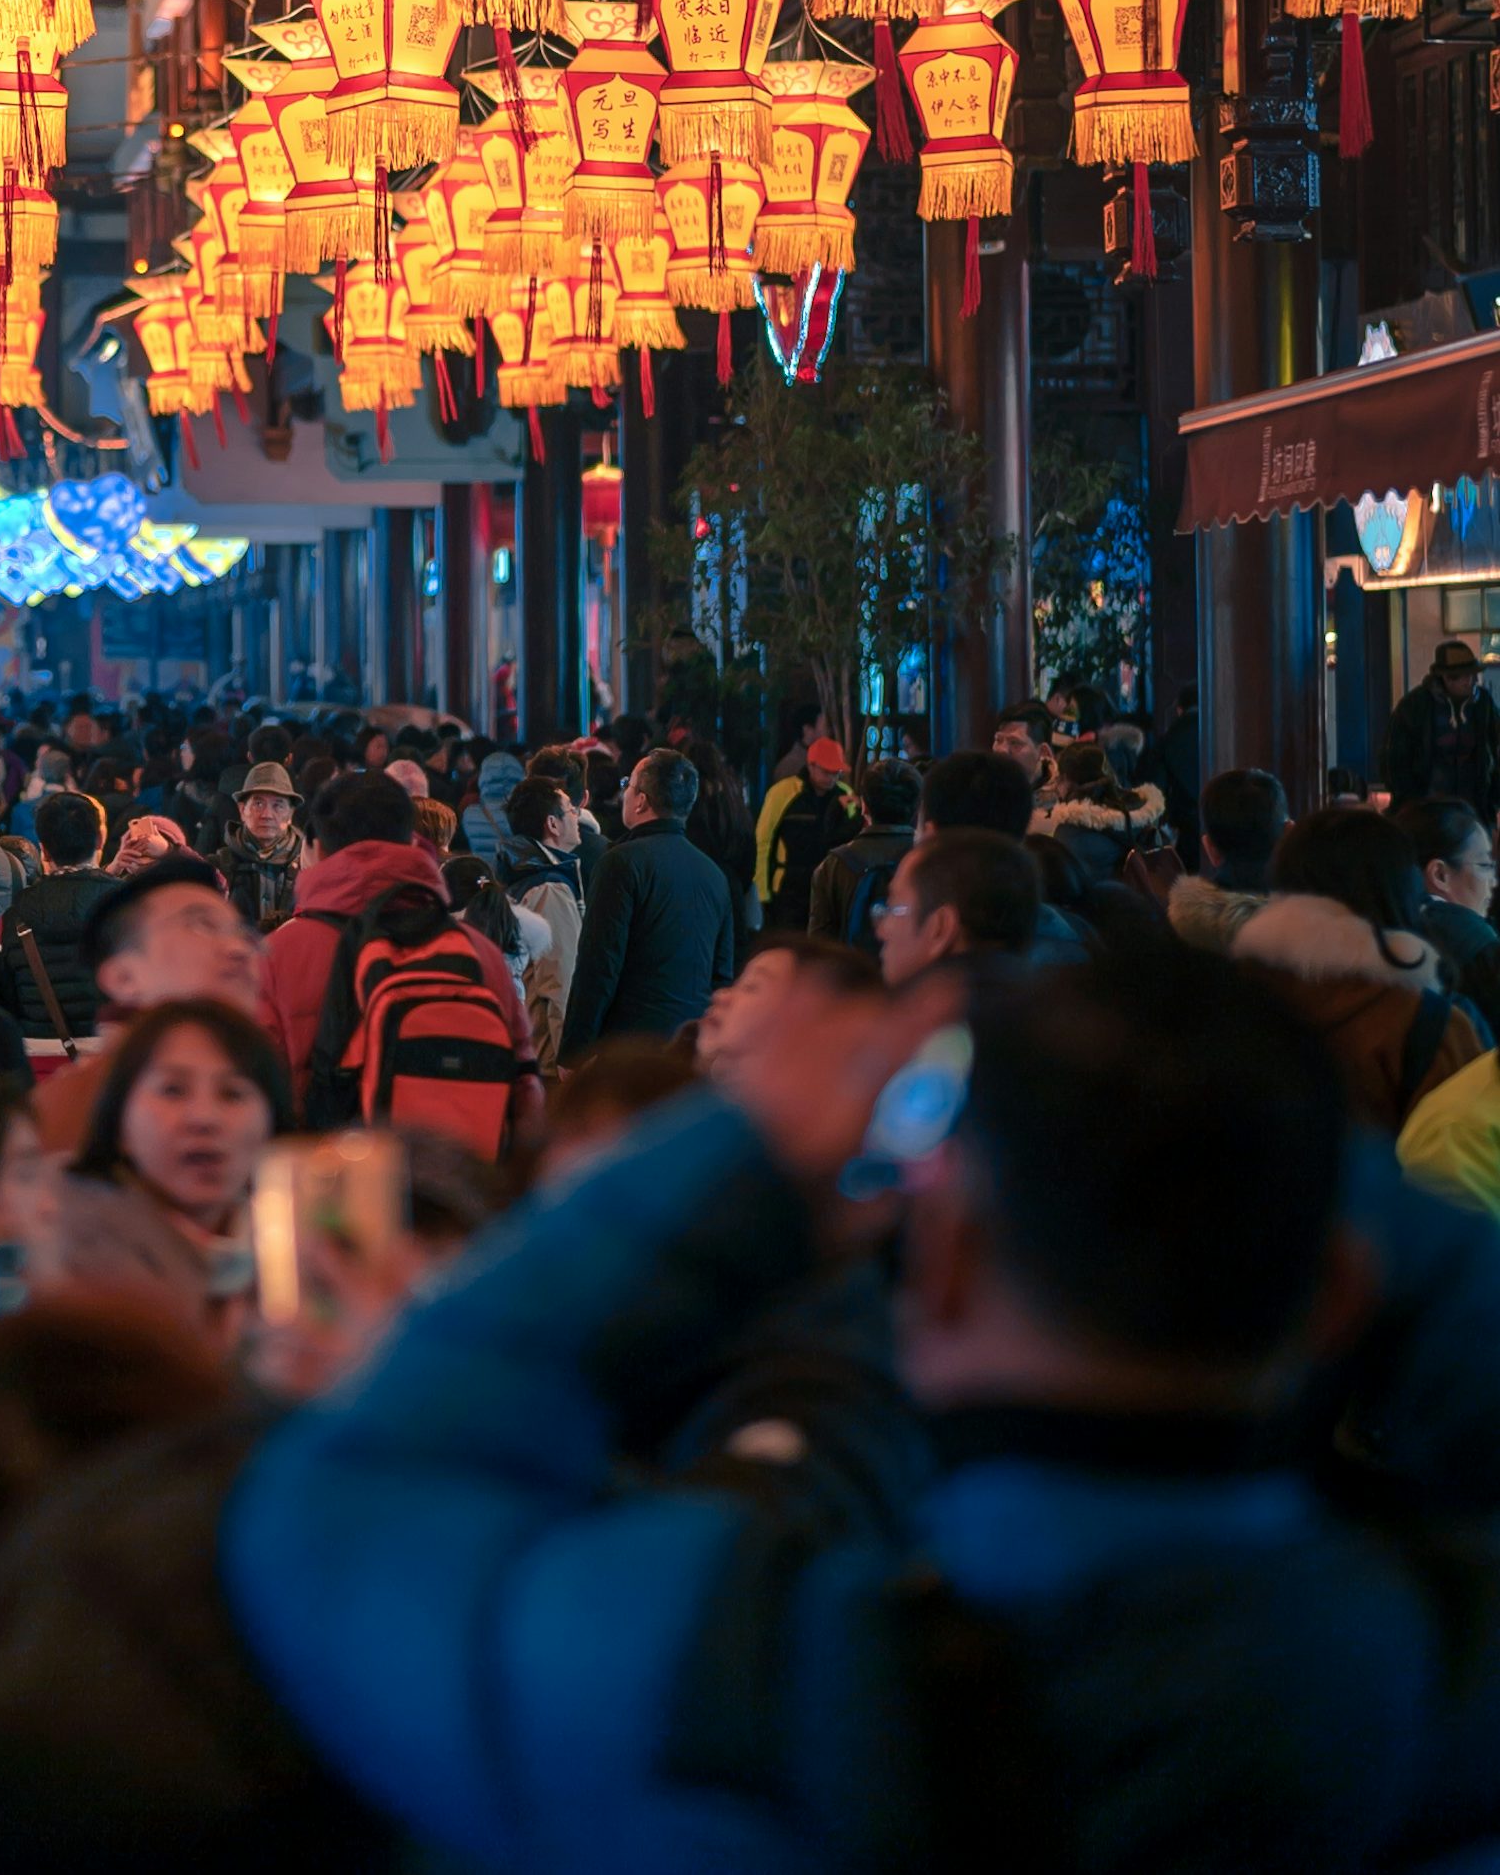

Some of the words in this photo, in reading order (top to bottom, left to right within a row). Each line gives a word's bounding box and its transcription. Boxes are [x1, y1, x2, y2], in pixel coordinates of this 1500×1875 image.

[345, 23, 373, 42] 之酒
[684, 23, 731, 46] 临近
[688, 50, 727, 64] 打一字
[593, 88, 639, 111] 元旦
[593, 117, 636, 140] 写生
[944, 115, 976, 127] 打一字
